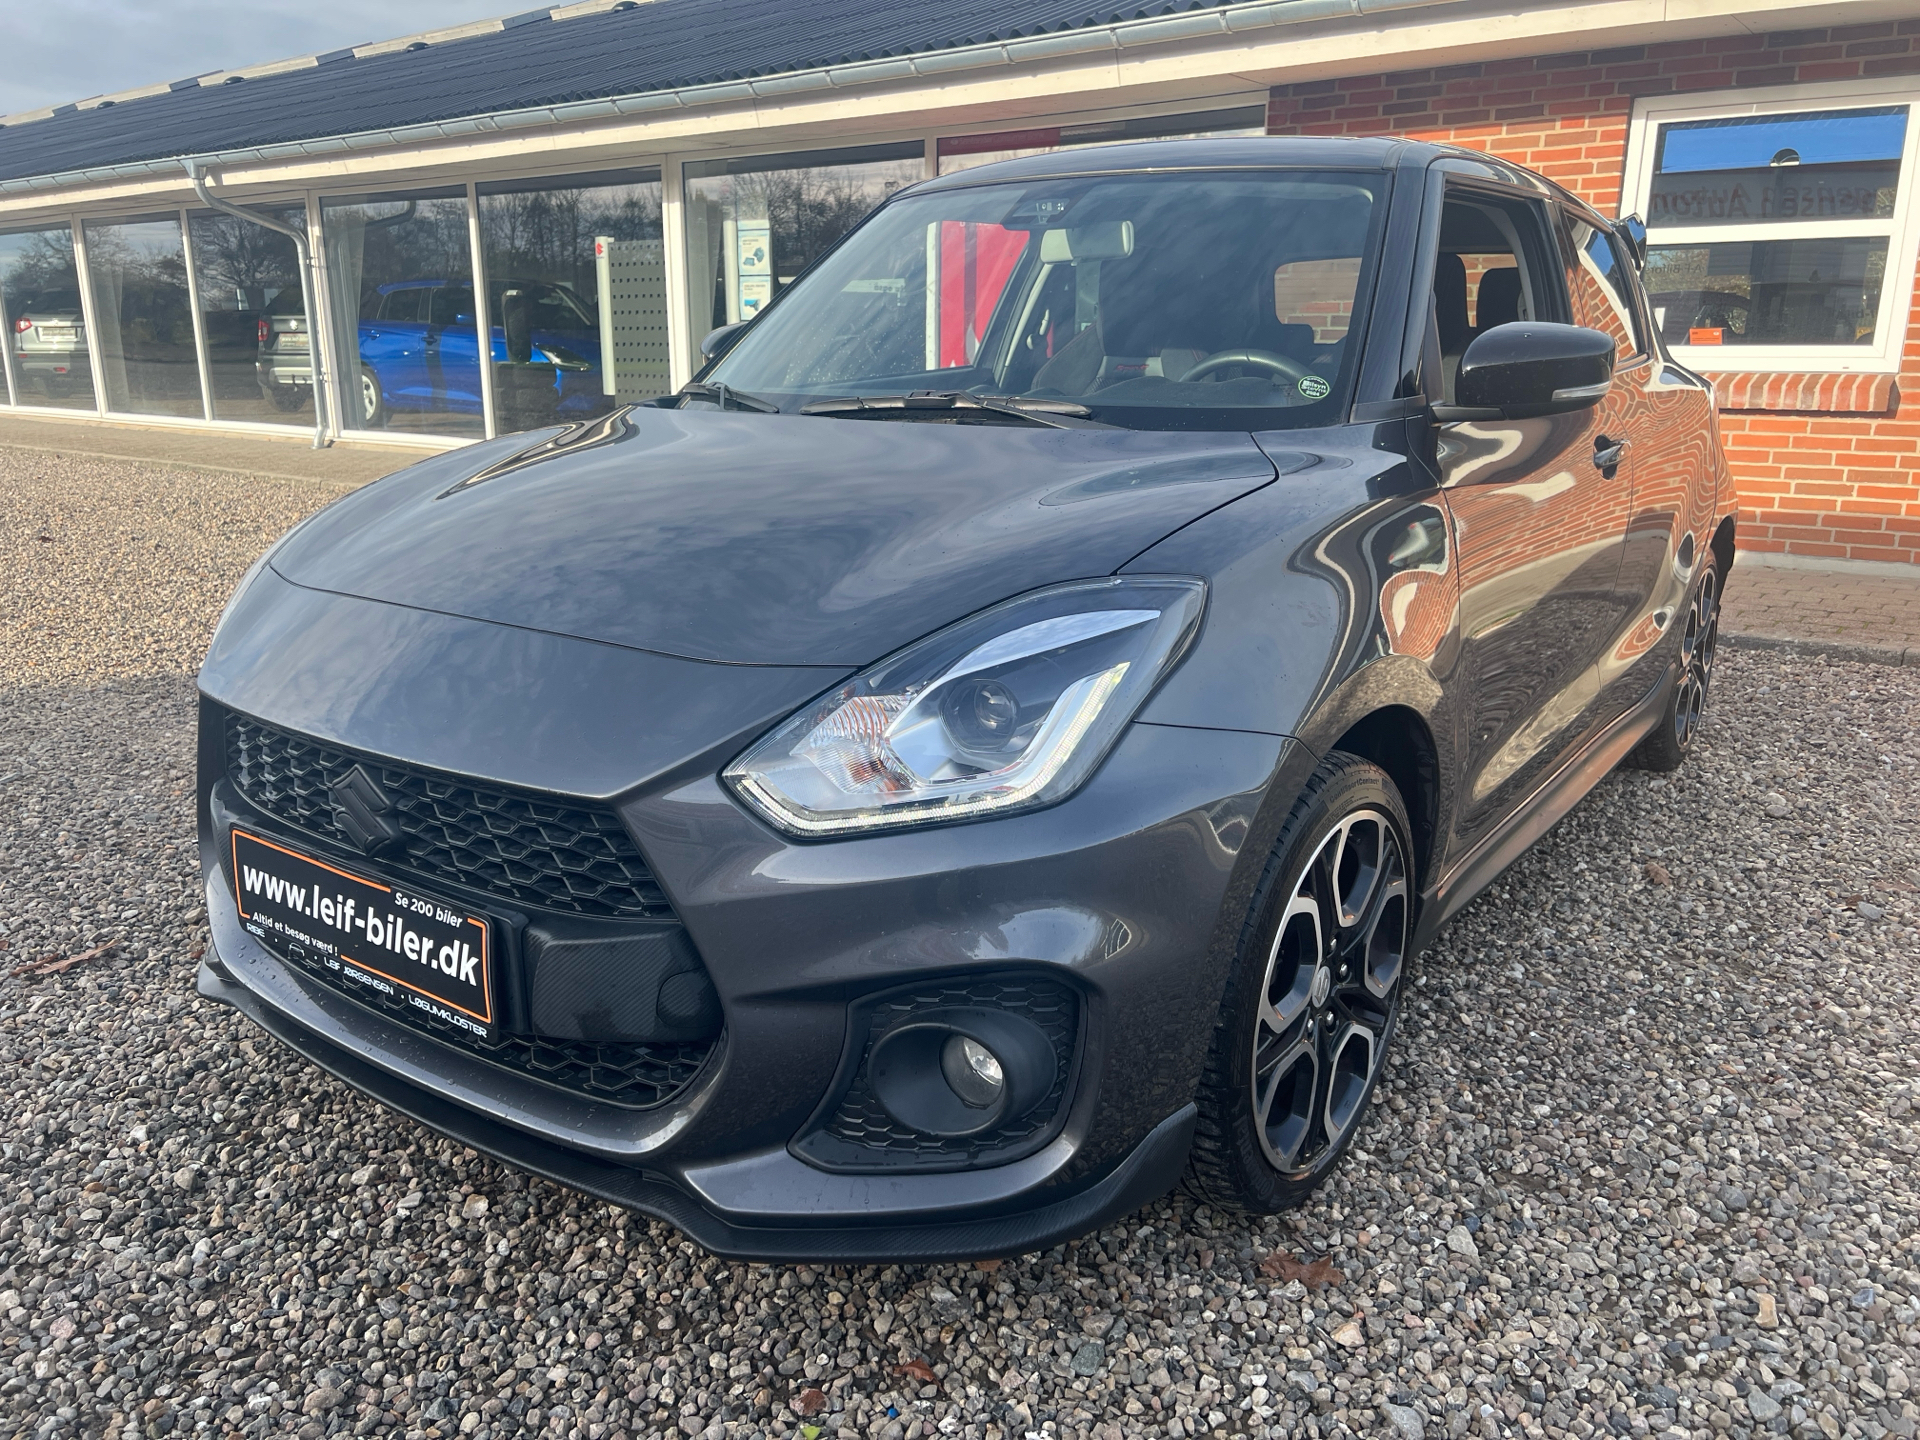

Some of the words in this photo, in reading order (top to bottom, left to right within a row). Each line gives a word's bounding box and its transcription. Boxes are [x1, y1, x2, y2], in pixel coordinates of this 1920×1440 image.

[243, 864, 480, 987] www.leif-biler.dk
[252, 911, 273, 928] Altid
[274, 921, 283, 932] et
[284, 924, 310, 945] besøg
[311, 936, 333, 954] værd
[395, 892, 408, 908] Se
[410, 898, 433, 917] 200
[436, 906, 463, 928] biler
[246, 922, 266, 938] RIBE
[343, 965, 394, 996] JØRGENSEN
[408, 994, 488, 1038] LØGUMKLOSTER
